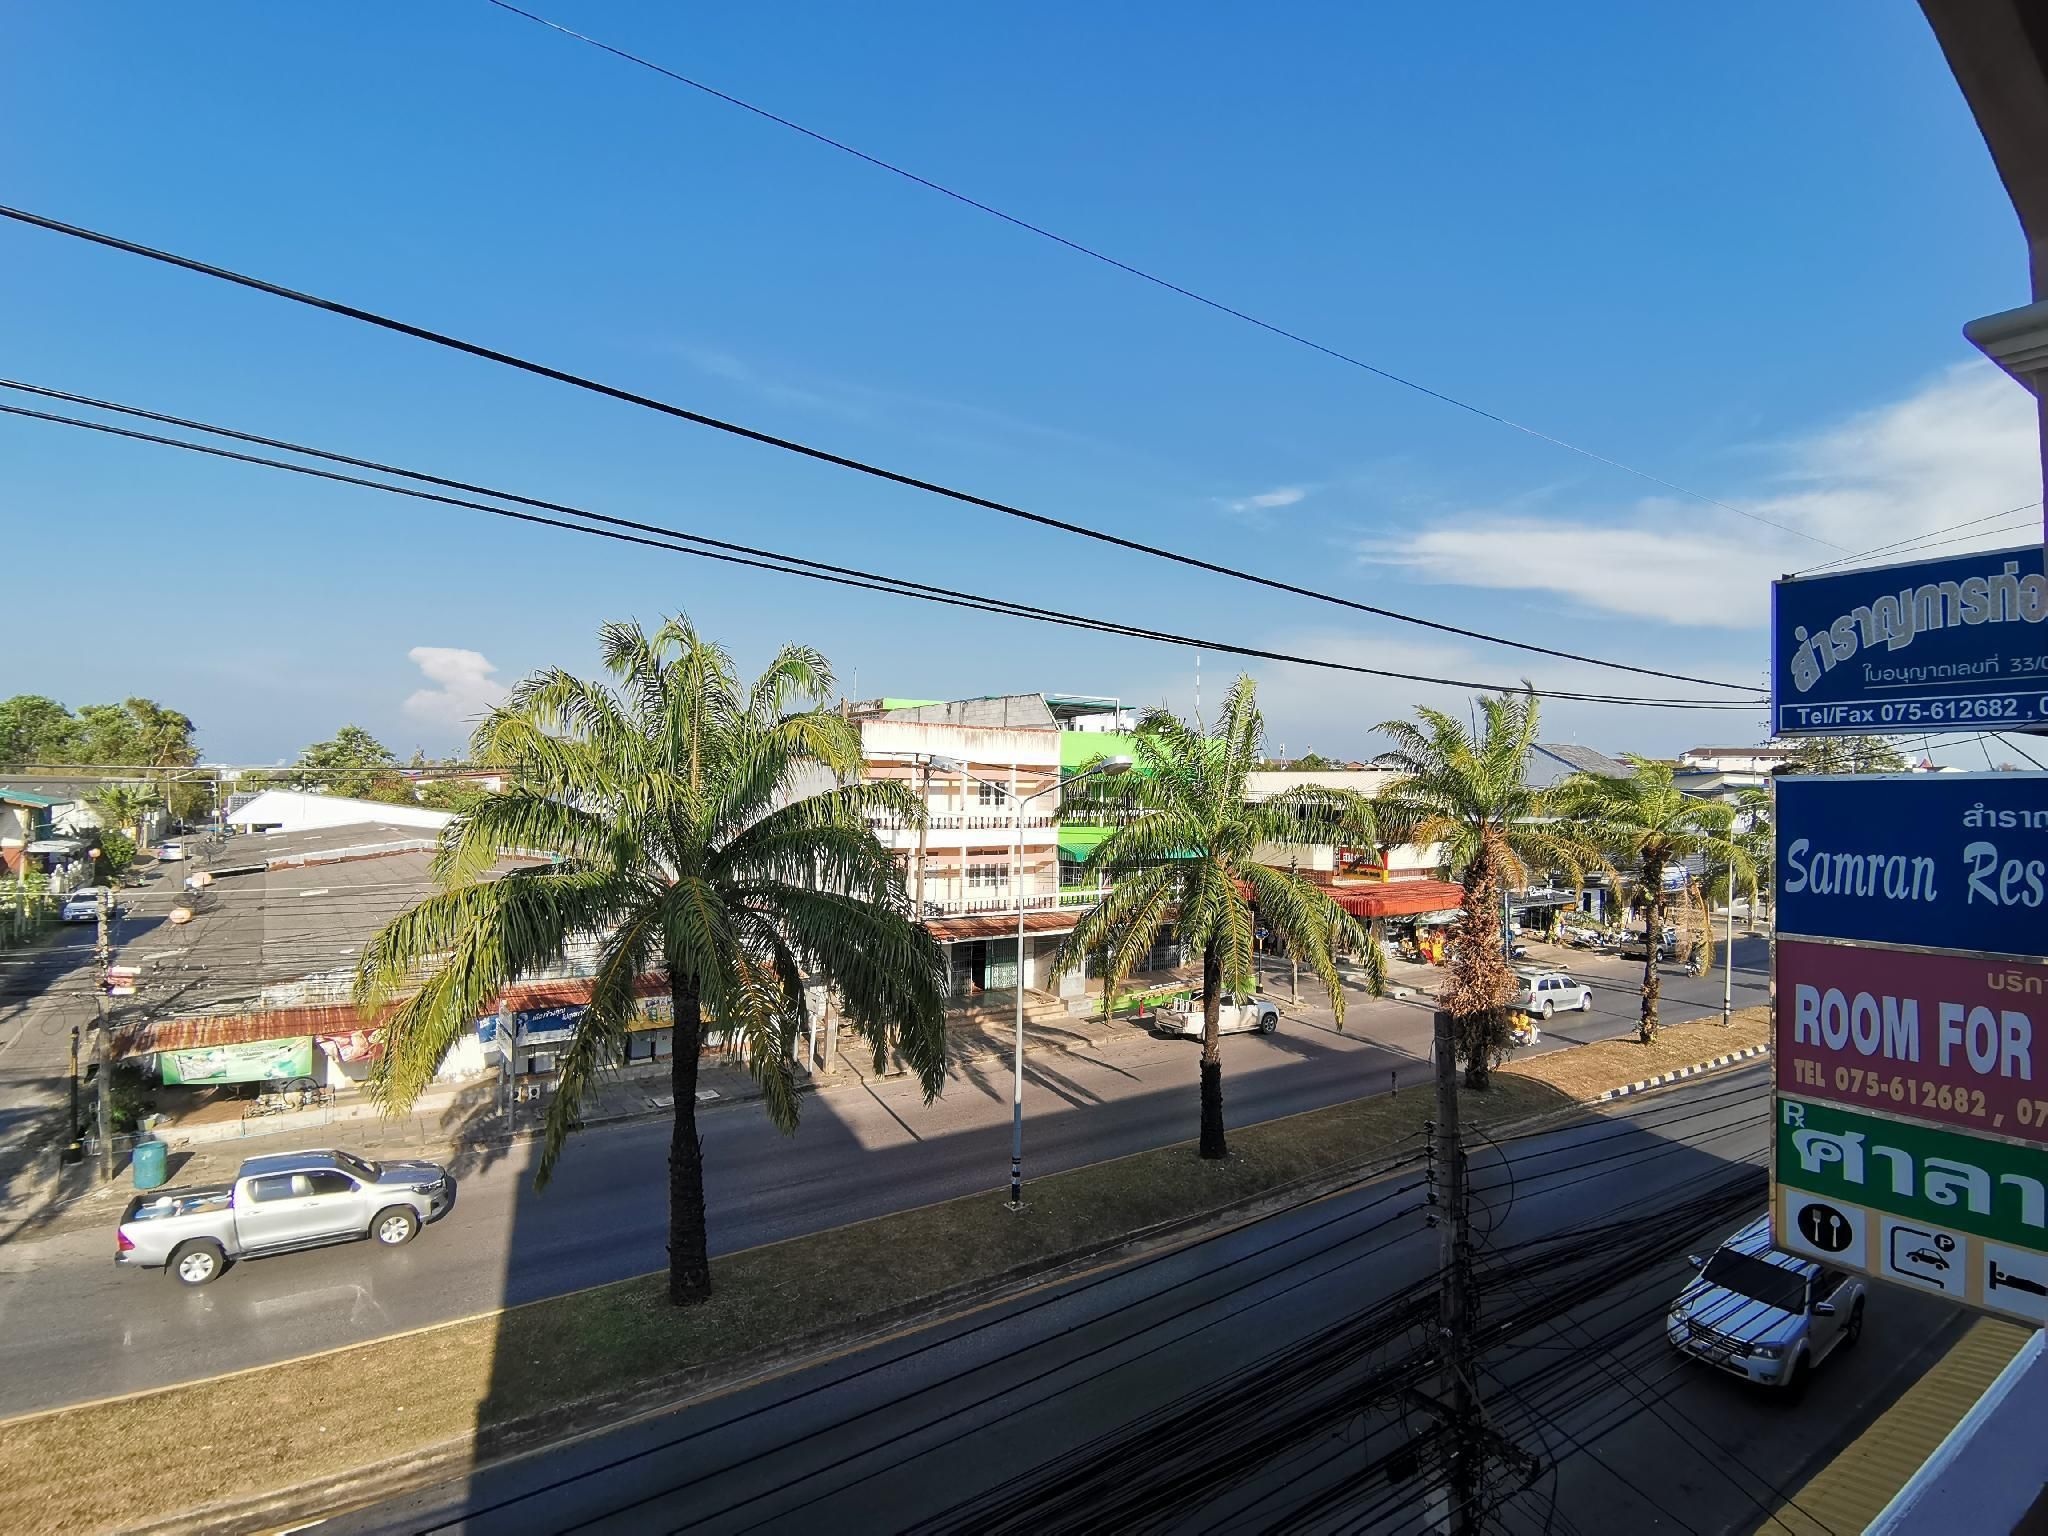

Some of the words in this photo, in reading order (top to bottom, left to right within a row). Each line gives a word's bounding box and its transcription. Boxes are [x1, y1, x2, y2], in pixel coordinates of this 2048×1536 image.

[1797, 707, 1874, 725] Tel/Fax
[1880, 698, 2018, 721] 075-612682
[1785, 838, 1937, 902] Samran
[1963, 841, 2045, 907] Res
[1987, 970, 2048, 995] บริก
[1794, 983, 1920, 1063] ROOM
[1939, 1002, 2032, 1081] FOR
[1794, 1059, 1826, 1087] TEL
[1835, 1066, 1986, 1117] 075-612682
